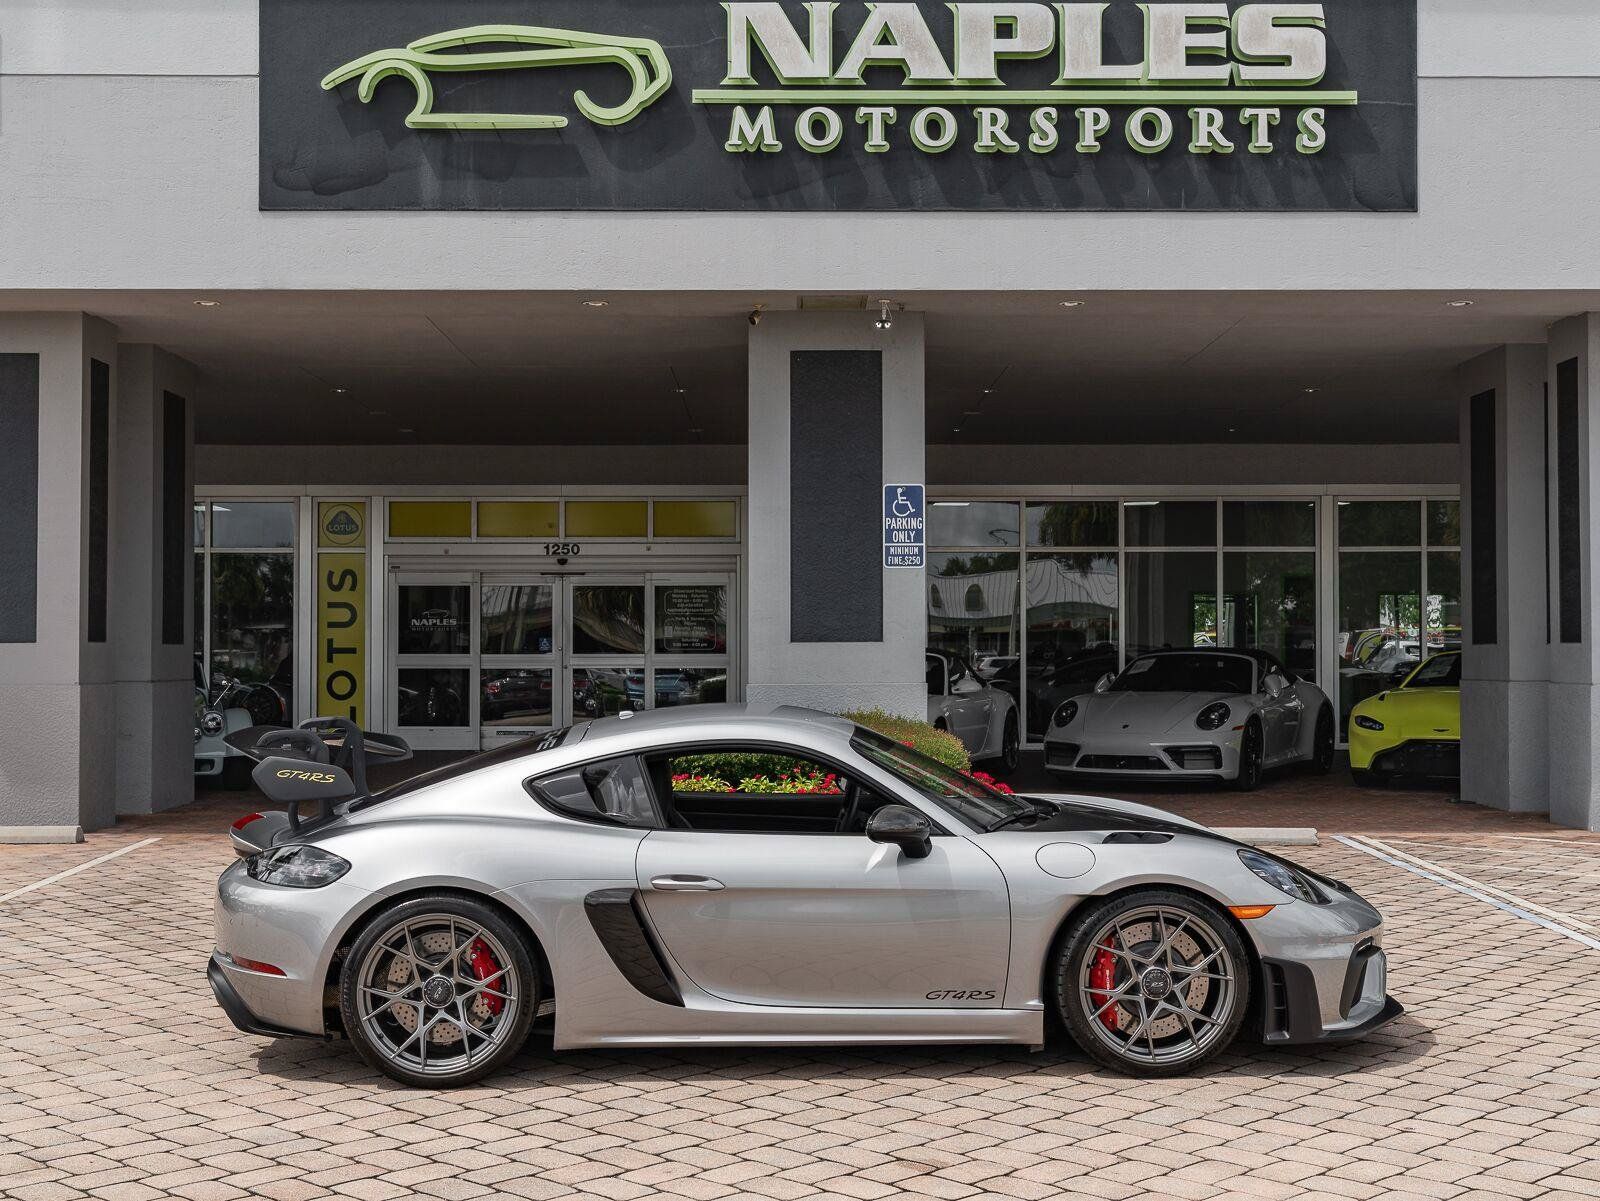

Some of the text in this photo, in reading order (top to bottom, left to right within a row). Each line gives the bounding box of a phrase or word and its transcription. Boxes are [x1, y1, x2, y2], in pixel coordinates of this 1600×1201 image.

[720, 2, 1326, 86] NAPLES
[724, 105, 1327, 154] MOTORSPORTS
[328, 524, 357, 532] LOTUS
[886, 518, 922, 529] PARKING
[893, 531, 915, 542] ONLY
[543, 543, 581, 555] 1250
[890, 547, 918, 555] MINIMUM
[888, 556, 920, 565] FINE $250
[411, 618, 457, 626] NAPLES
[276, 769, 336, 783] GT4RS
[925, 990, 996, 1000] GT4RS
